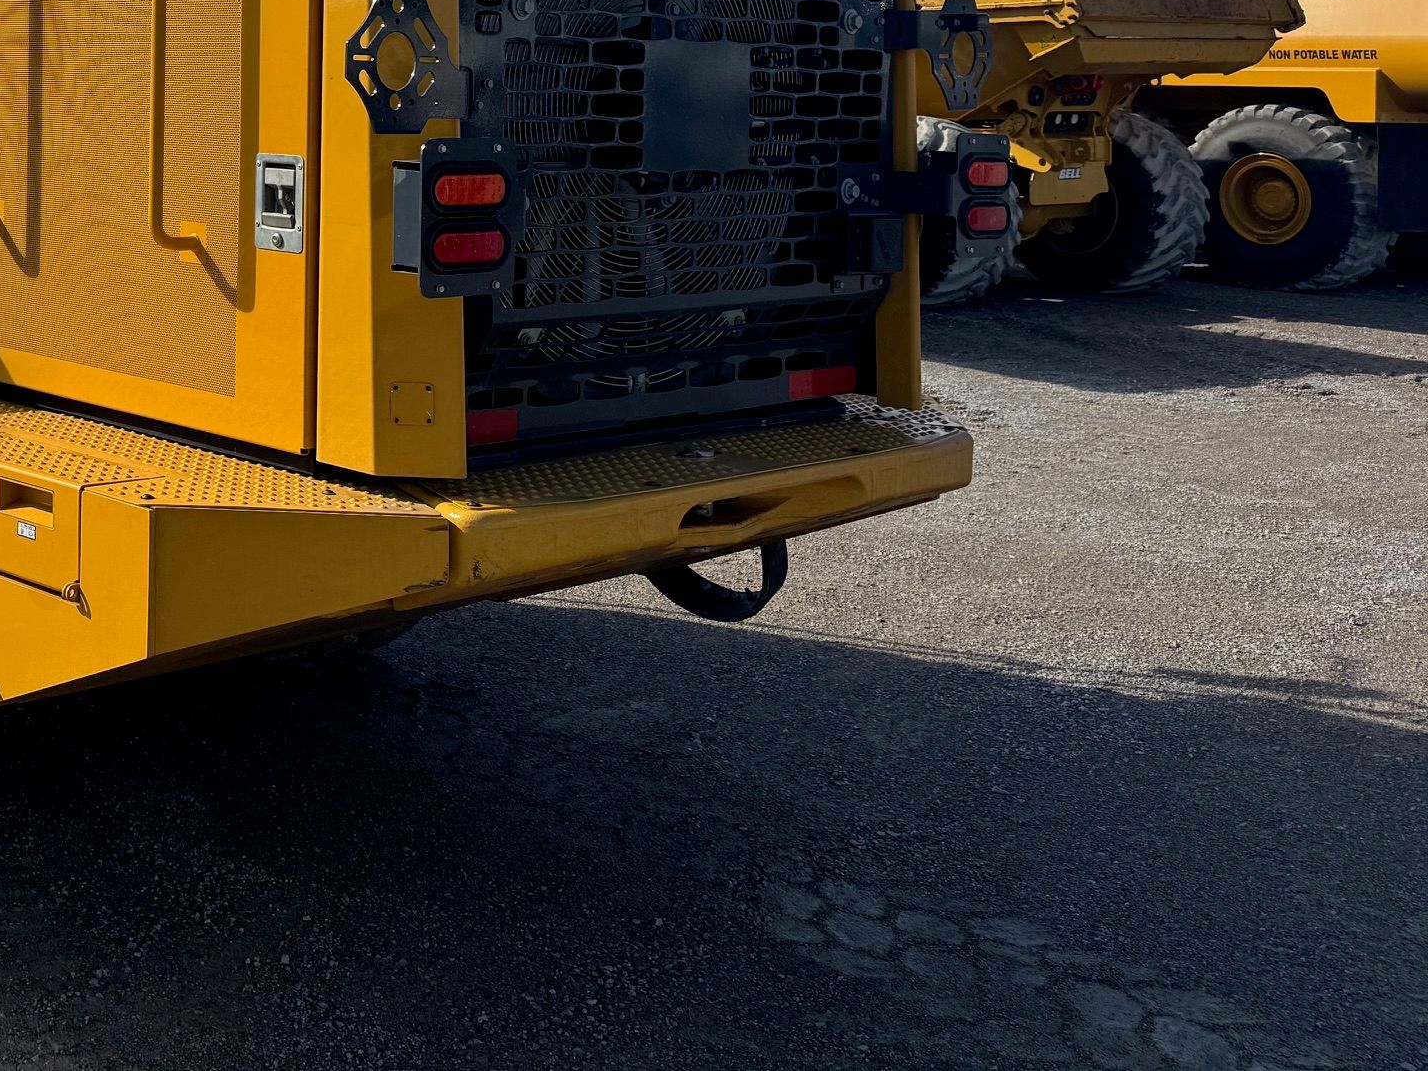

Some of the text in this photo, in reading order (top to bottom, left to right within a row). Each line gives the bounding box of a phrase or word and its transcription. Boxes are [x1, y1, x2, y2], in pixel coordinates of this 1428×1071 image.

[1269, 49, 1378, 60] NON POTABLE WATER
[1059, 168, 1081, 179] BELL
